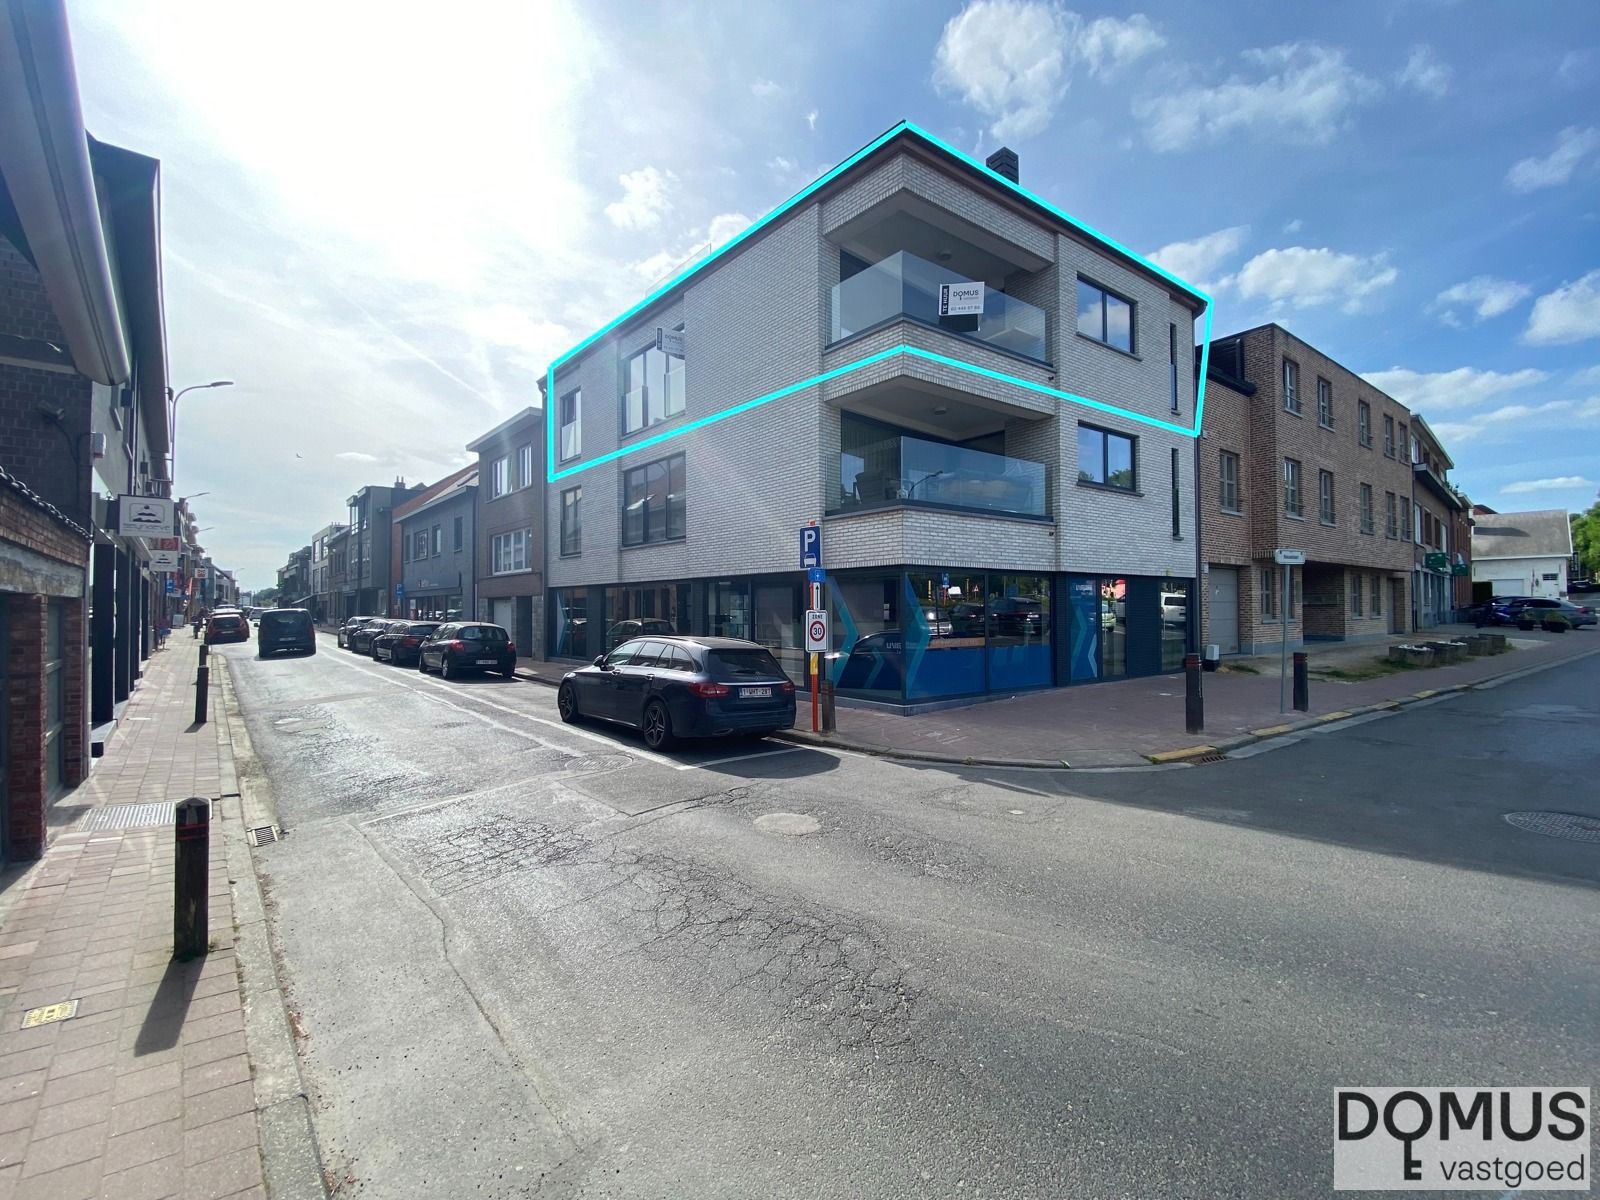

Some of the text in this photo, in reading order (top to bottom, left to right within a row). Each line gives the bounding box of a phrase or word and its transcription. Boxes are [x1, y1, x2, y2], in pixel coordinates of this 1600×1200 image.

[953, 290, 979, 299] DOMUS
[804, 530, 816, 552] P
[813, 627, 822, 635] 30
